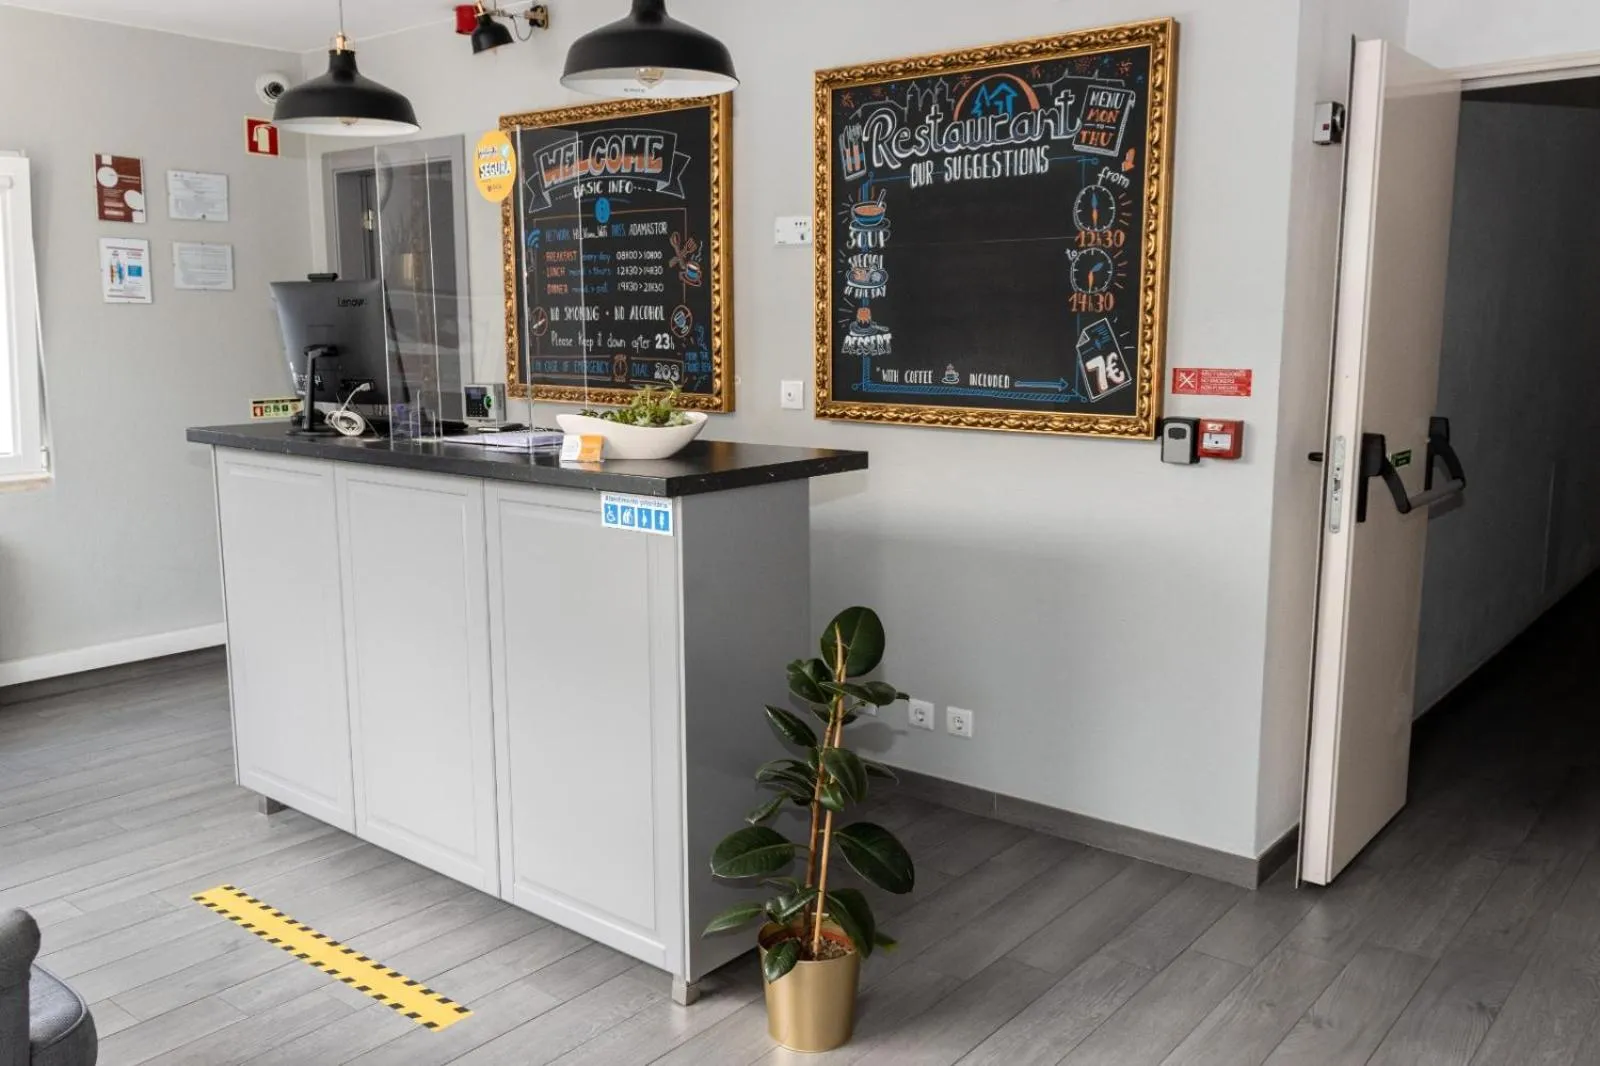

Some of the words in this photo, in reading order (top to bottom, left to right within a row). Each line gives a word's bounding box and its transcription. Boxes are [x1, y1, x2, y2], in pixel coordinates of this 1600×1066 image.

[1089, 91, 1126, 109] MENU
[1087, 107, 1120, 123] MON
[862, 89, 1082, 169] Restaurant
[1079, 129, 1115, 147] THU
[540, 134, 664, 188] WELCOME
[910, 160, 934, 188] OUR
[944, 145, 1050, 182] SUGGESTIONS
[608, 179, 634, 194] INFO
[1097, 166, 1130, 188] from
[628, 221, 668, 237] ADAMASTOR
[846, 229, 891, 249] SOUP
[1065, 248, 1078, 260] to
[550, 305, 560, 321] NO
[564, 305, 600, 321] SMOKING
[614, 306, 625, 321] NO
[629, 304, 665, 321] ALCOHOL
[551, 330, 573, 347] Please
[607, 333, 626, 349] down
[631, 332, 650, 356] after
[841, 333, 893, 356] DESSERT
[654, 362, 680, 382] 203
[904, 369, 934, 384] COFFEE
[969, 373, 1011, 389] INCLUDED
[1085, 352, 1126, 393] 7€
